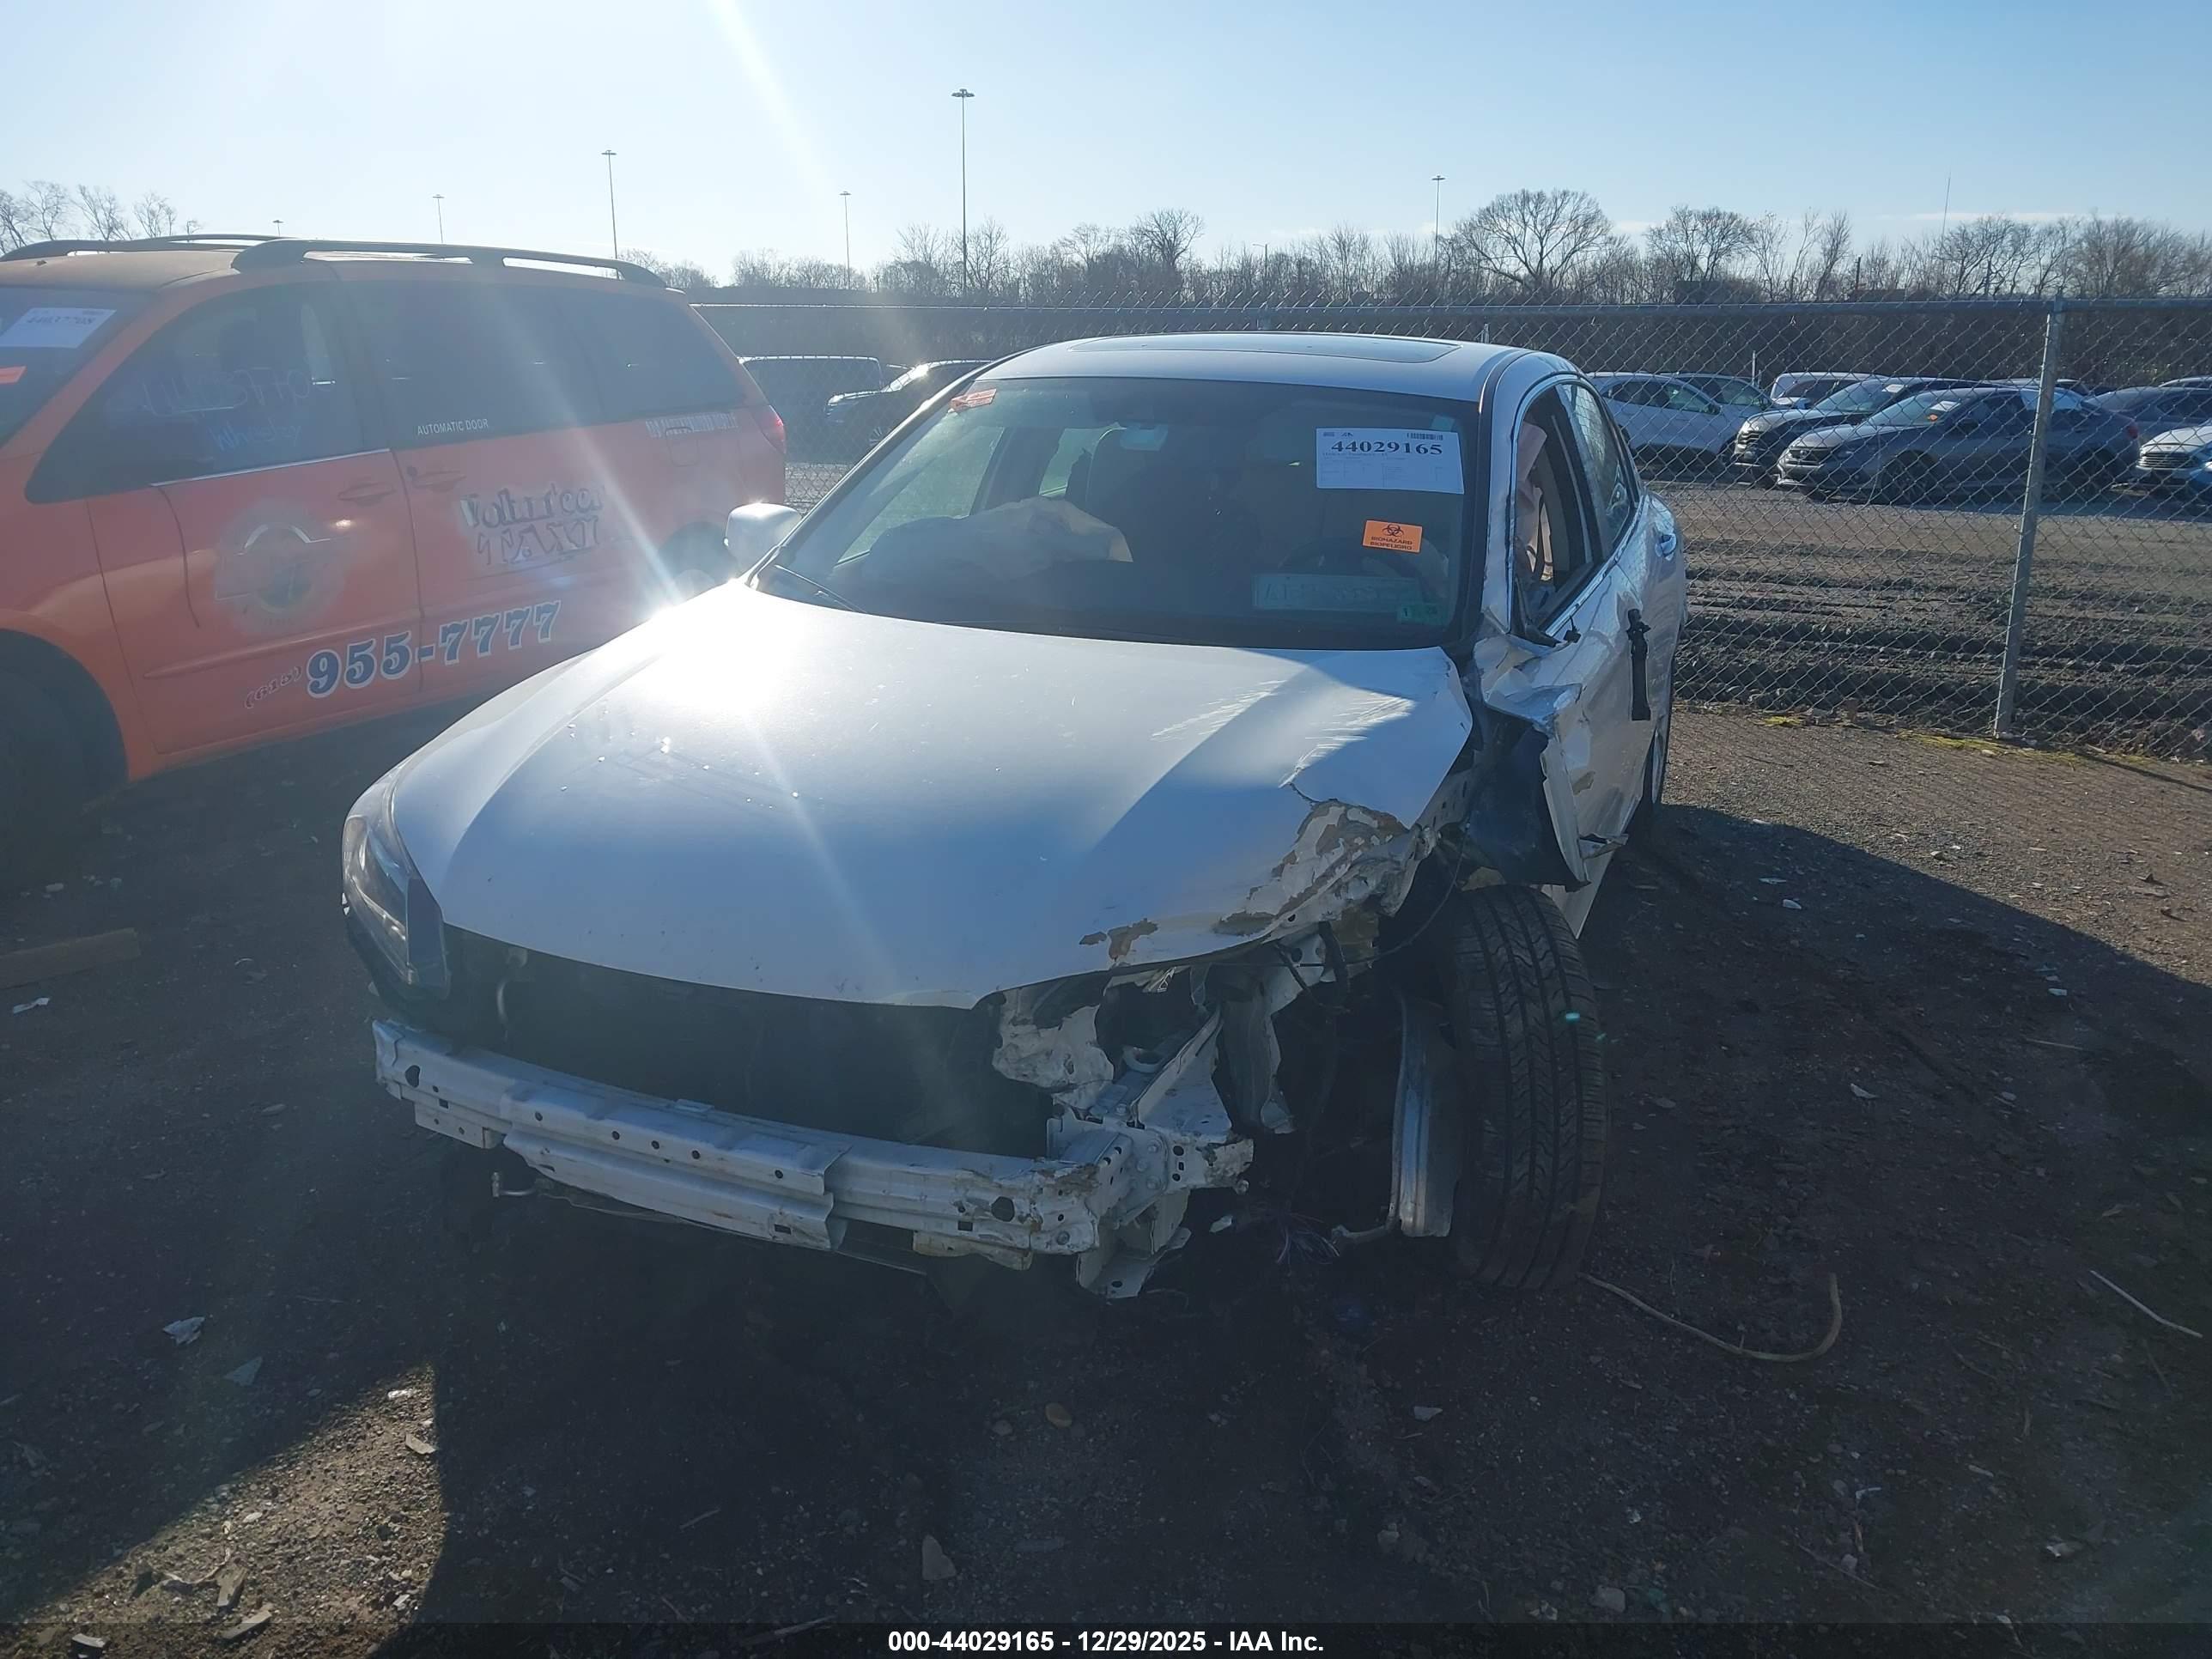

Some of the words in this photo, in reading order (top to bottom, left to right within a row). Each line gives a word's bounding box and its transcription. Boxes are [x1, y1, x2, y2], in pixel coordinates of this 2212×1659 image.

[417, 421, 465, 435] AUTOMATIC
[465, 418, 489, 430] DOOR
[1331, 441, 1443, 455] 44029165
[1370, 541, 1413, 550] BIOPELIGRO
[1371, 535, 1413, 545] BIOHAZARD
[306, 599, 562, 700] 955-7777
